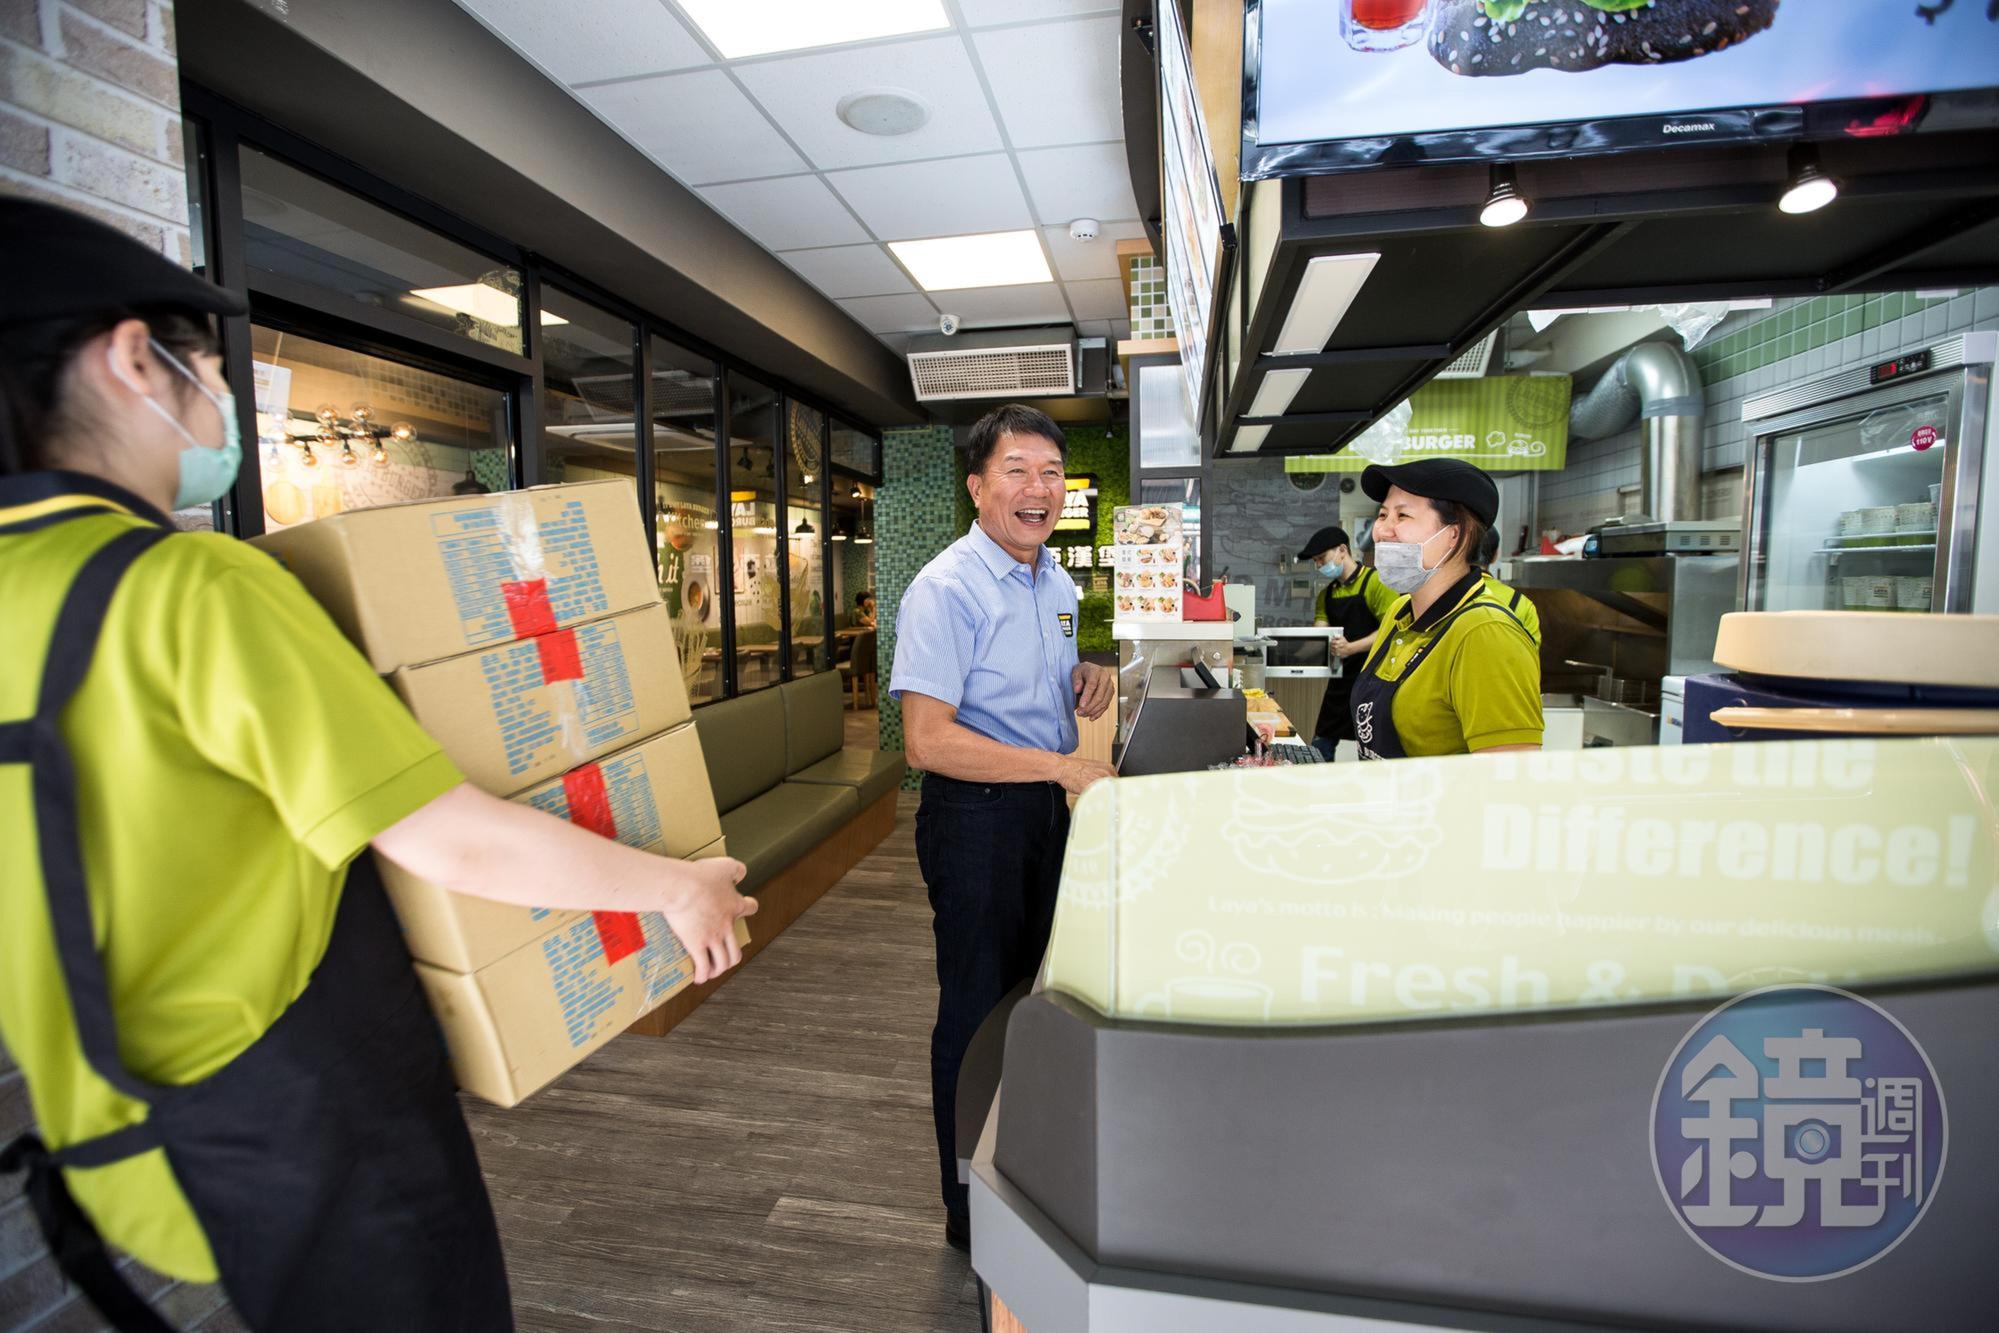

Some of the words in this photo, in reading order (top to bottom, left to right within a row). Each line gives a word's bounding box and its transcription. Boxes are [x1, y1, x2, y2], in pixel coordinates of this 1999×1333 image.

[1663, 123, 1715, 133] Decamax
[1403, 434, 1476, 450] BURGER
[1916, 435, 1933, 446] 110V
[1481, 803, 1976, 887] Difference!
[1280, 901, 1346, 919] motto
[1472, 910, 1552, 930] people
[1655, 914, 1682, 936] by
[1690, 918, 1736, 936] our
[1739, 916, 1851, 939] delicious
[1301, 945, 1550, 1011] Fresh
[1580, 958, 1643, 1003] &
